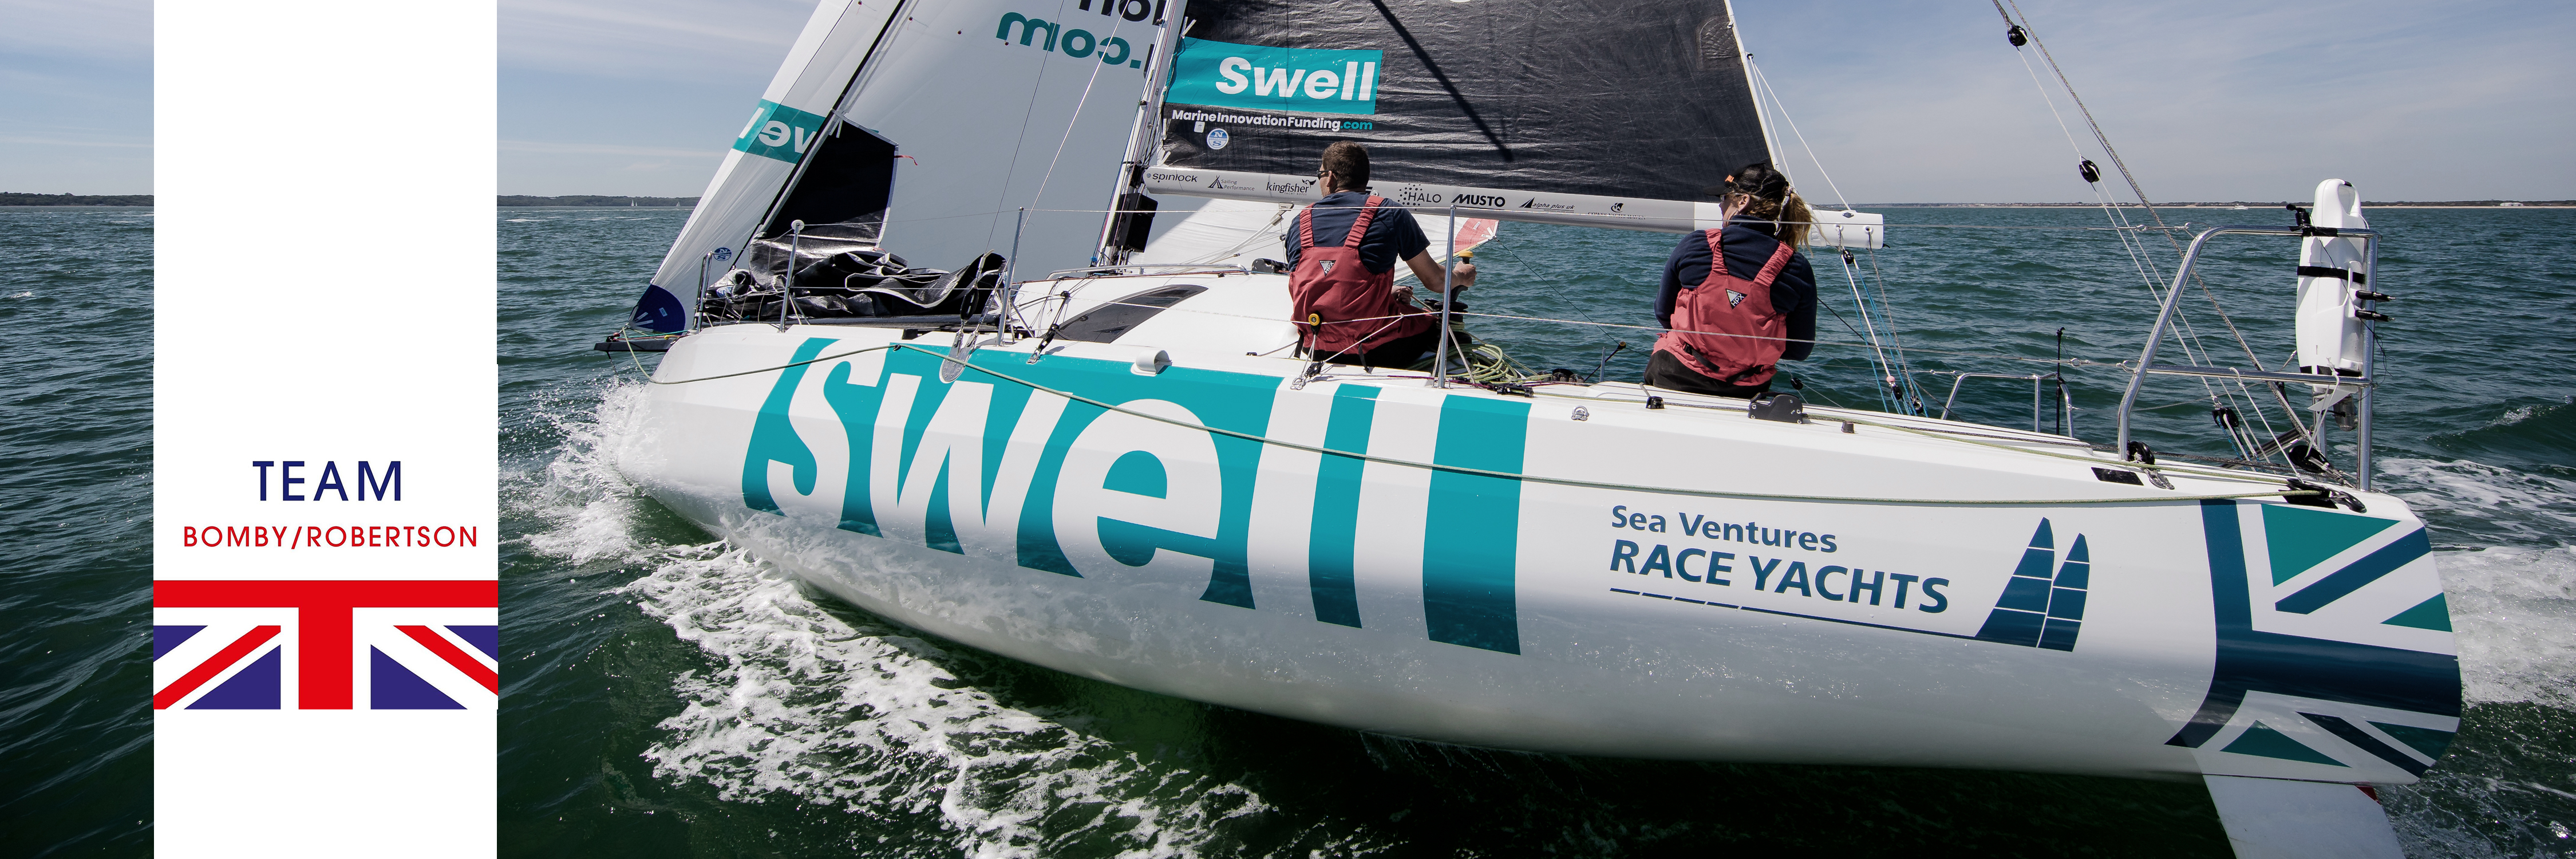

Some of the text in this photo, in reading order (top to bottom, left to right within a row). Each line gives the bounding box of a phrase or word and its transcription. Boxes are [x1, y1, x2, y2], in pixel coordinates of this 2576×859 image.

[1215, 57, 1375, 101] Swell
[1152, 173, 1198, 183] spinlock
[1266, 182, 1309, 193] kingfisher
[1408, 192, 1442, 203] HALO
[1451, 194, 1506, 207] MUSTO
[1324, 261, 1334, 274] HPX
[1730, 293, 1745, 307] HPX
[767, 345, 1447, 642] Swell
[1611, 505, 1838, 553] Sea Ventures
[1610, 539, 1950, 614] RACE YACHTS
